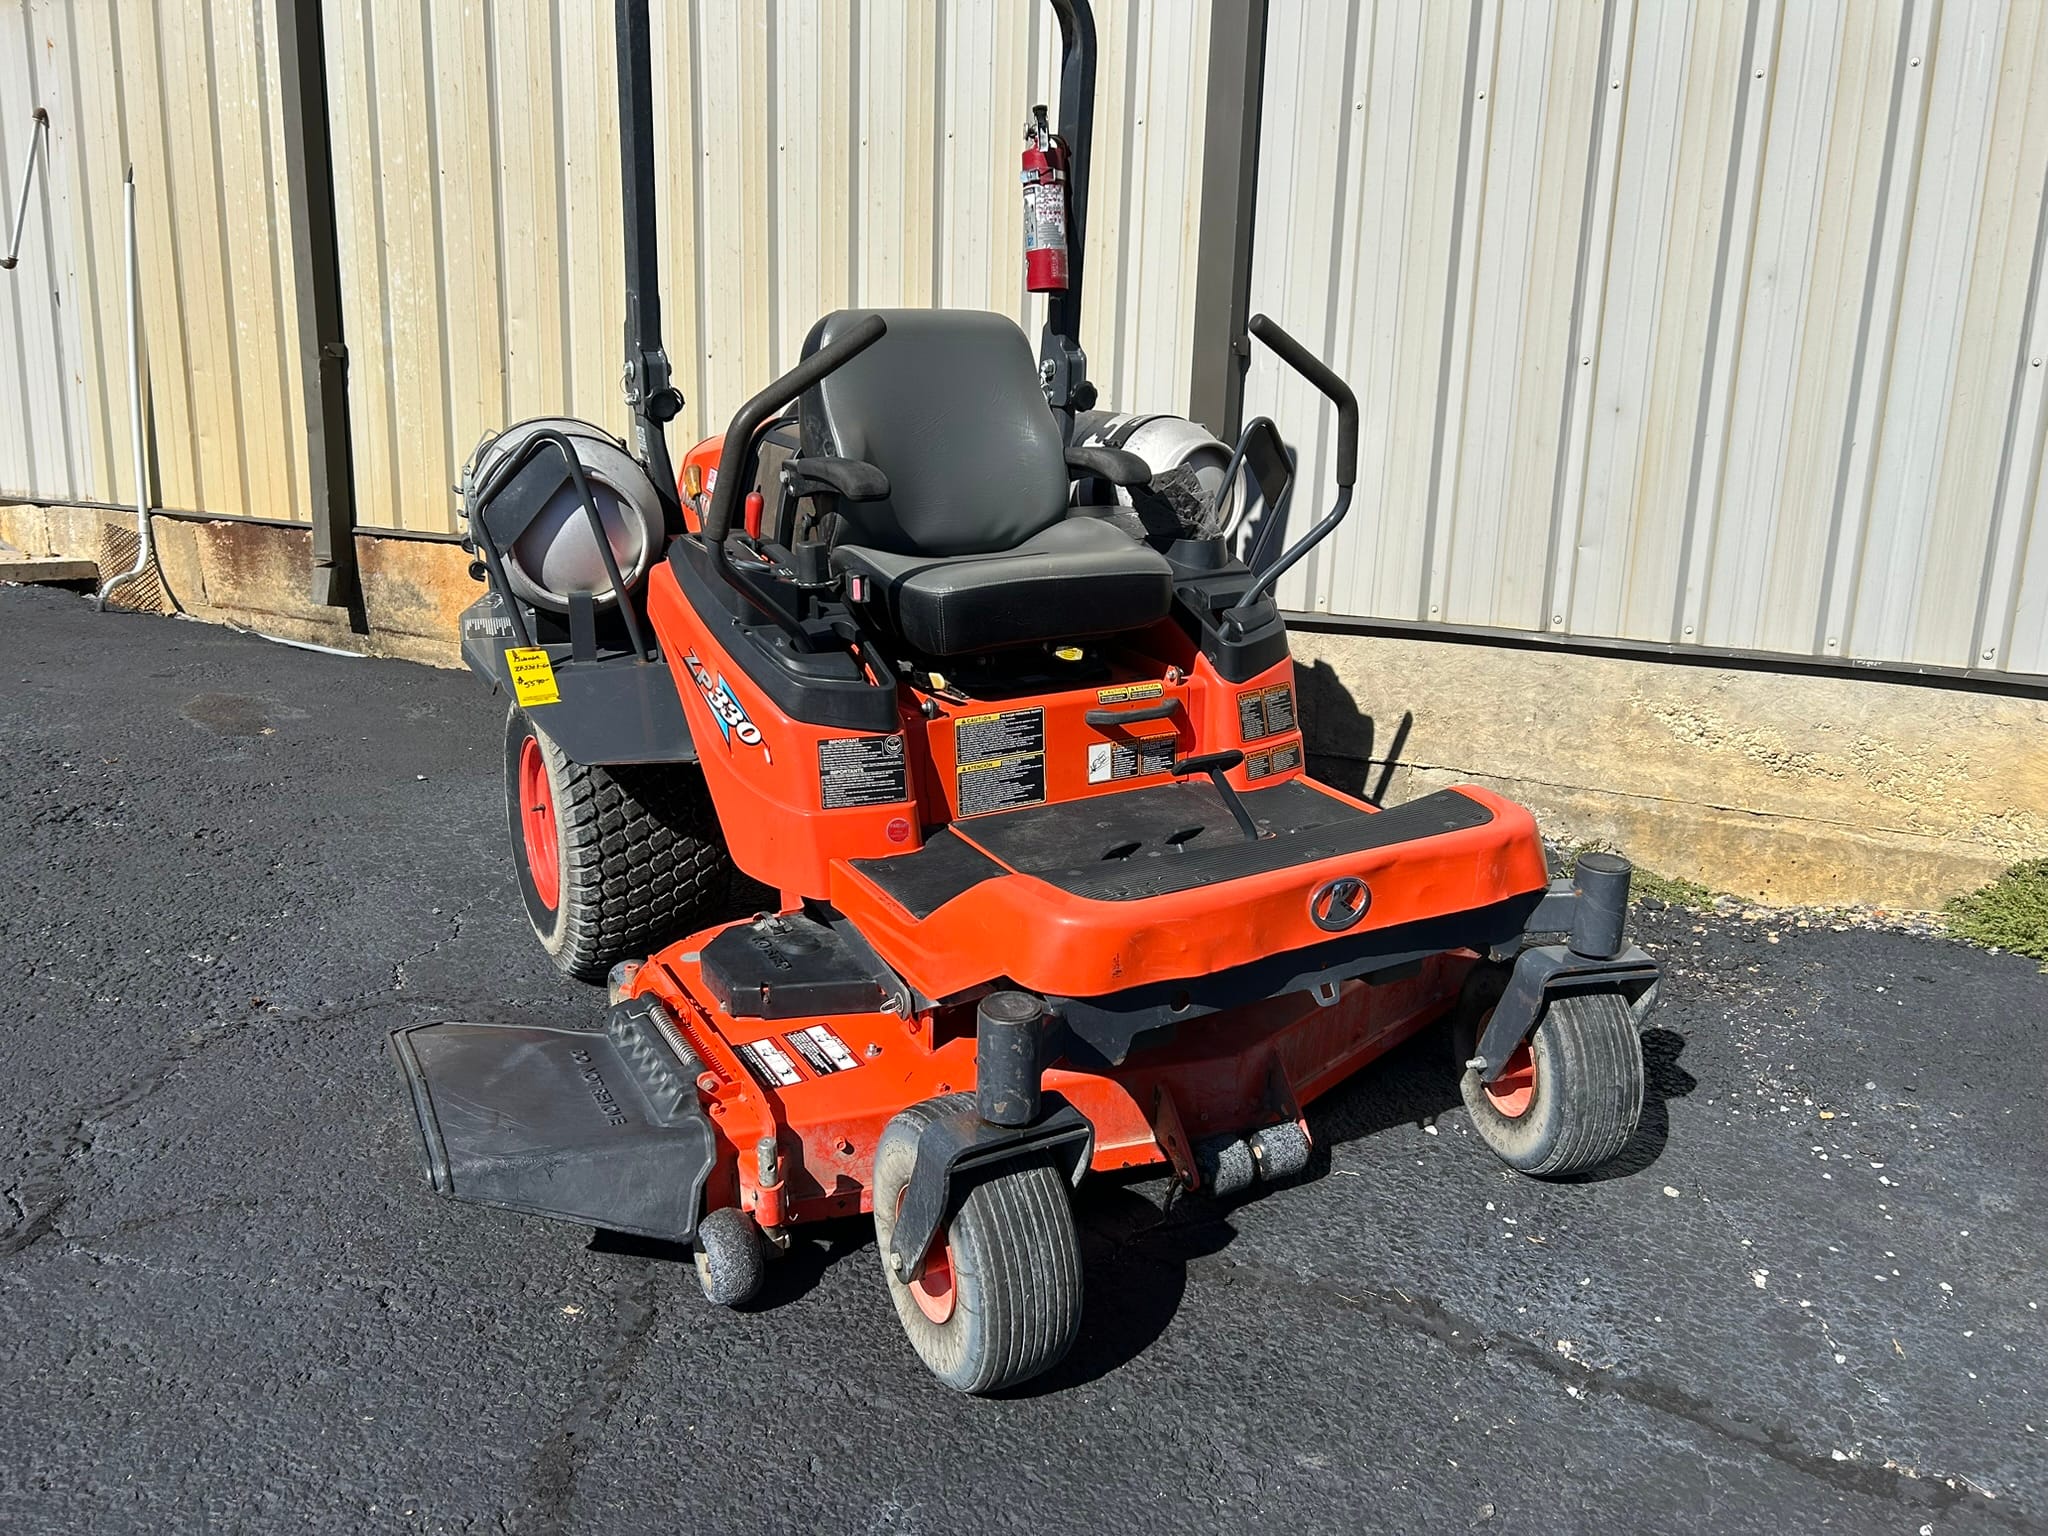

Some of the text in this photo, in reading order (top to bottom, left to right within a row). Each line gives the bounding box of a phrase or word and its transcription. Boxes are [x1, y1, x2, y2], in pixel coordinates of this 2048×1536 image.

[683, 647, 762, 746] ZP330
[966, 715, 992, 724] CAUTION
[828, 737, 860, 745] IMPORTANT
[829, 767, 865, 775] IMPORTANTE
[571, 1048, 628, 1127] DO NOT REMOVE
